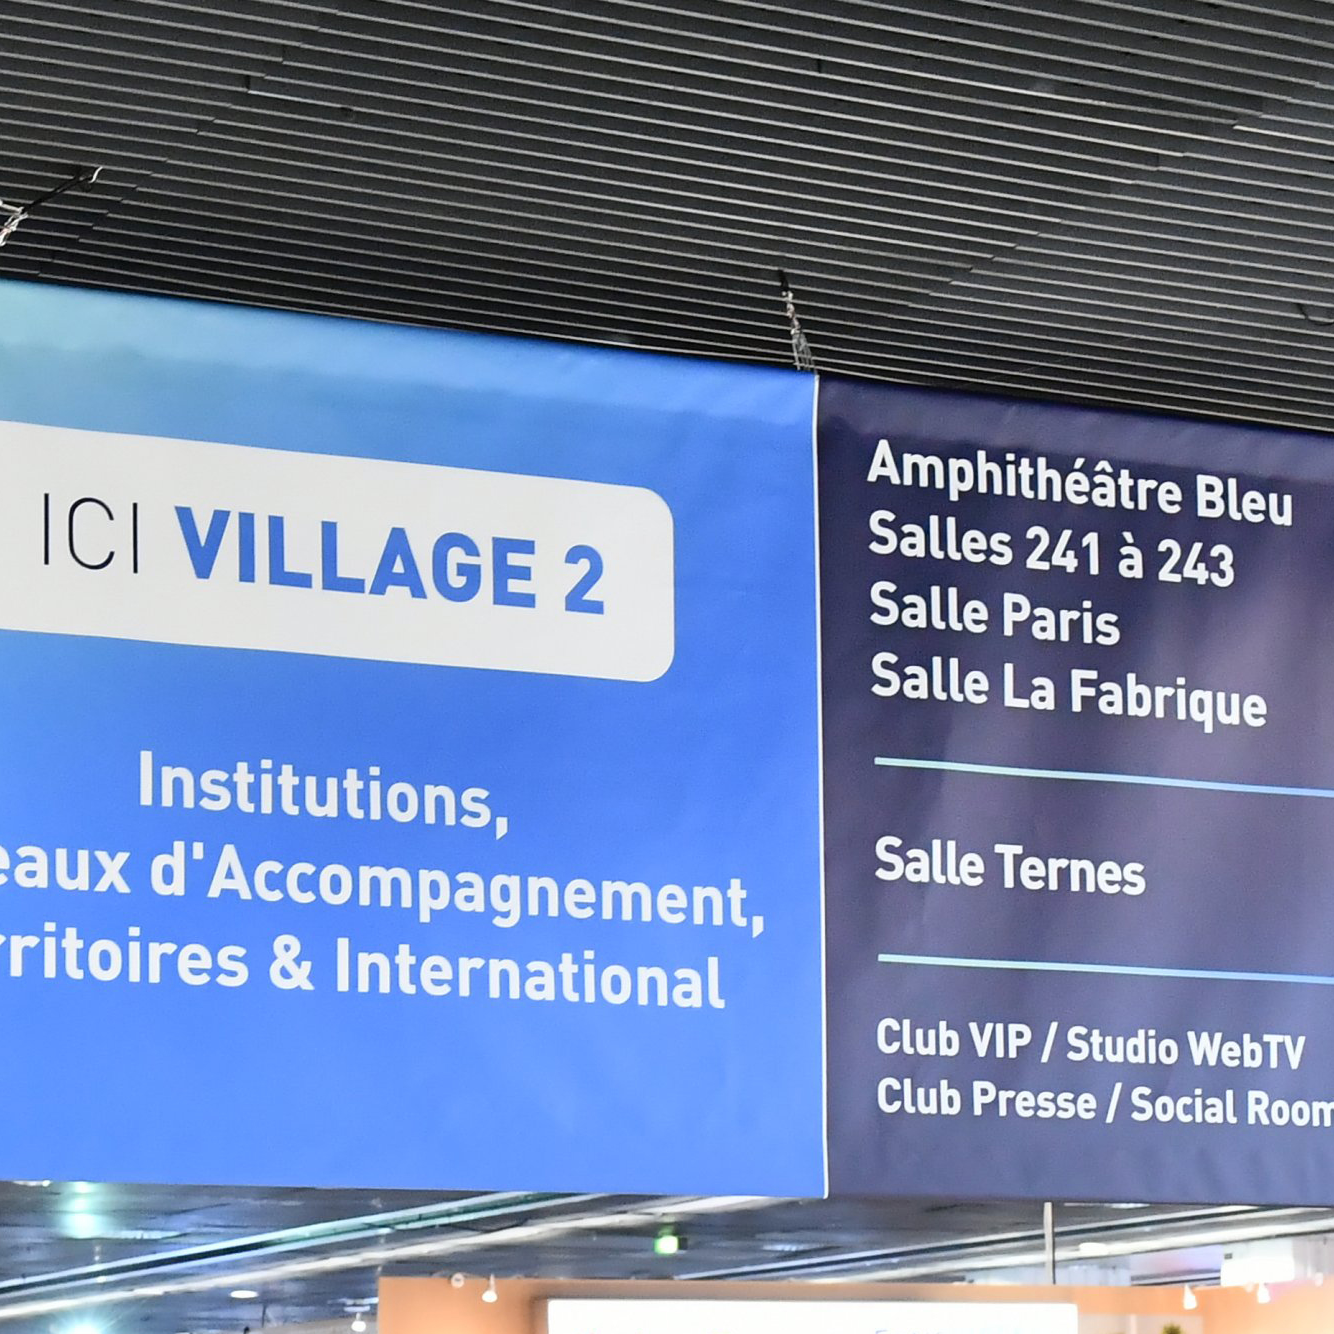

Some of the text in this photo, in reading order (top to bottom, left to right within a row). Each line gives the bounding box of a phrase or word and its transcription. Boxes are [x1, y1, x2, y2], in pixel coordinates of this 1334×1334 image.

[867, 439, 1293, 526] Amphithéâtre Bleu
[43, 492, 604, 615] ICI VILLAGE 2
[868, 509, 1235, 588] Salles 241 à 243
[870, 580, 1120, 646] Salle Paris
[871, 651, 1268, 734] Salle La Fabrique
[140, 750, 508, 839] Institutions,
[151, 840, 764, 938] d'Accompagnement,
[874, 835, 1146, 896] Salle Ternes
[269, 934, 314, 991] &
[337, 937, 725, 1009] International
[876, 1017, 1307, 1071] Club VIP / Studio WebTV
[877, 1076, 962, 1116] Club
[972, 1080, 1098, 1120] Presse
[1104, 1081, 1124, 1124] /
[1130, 1085, 1238, 1125] Social
